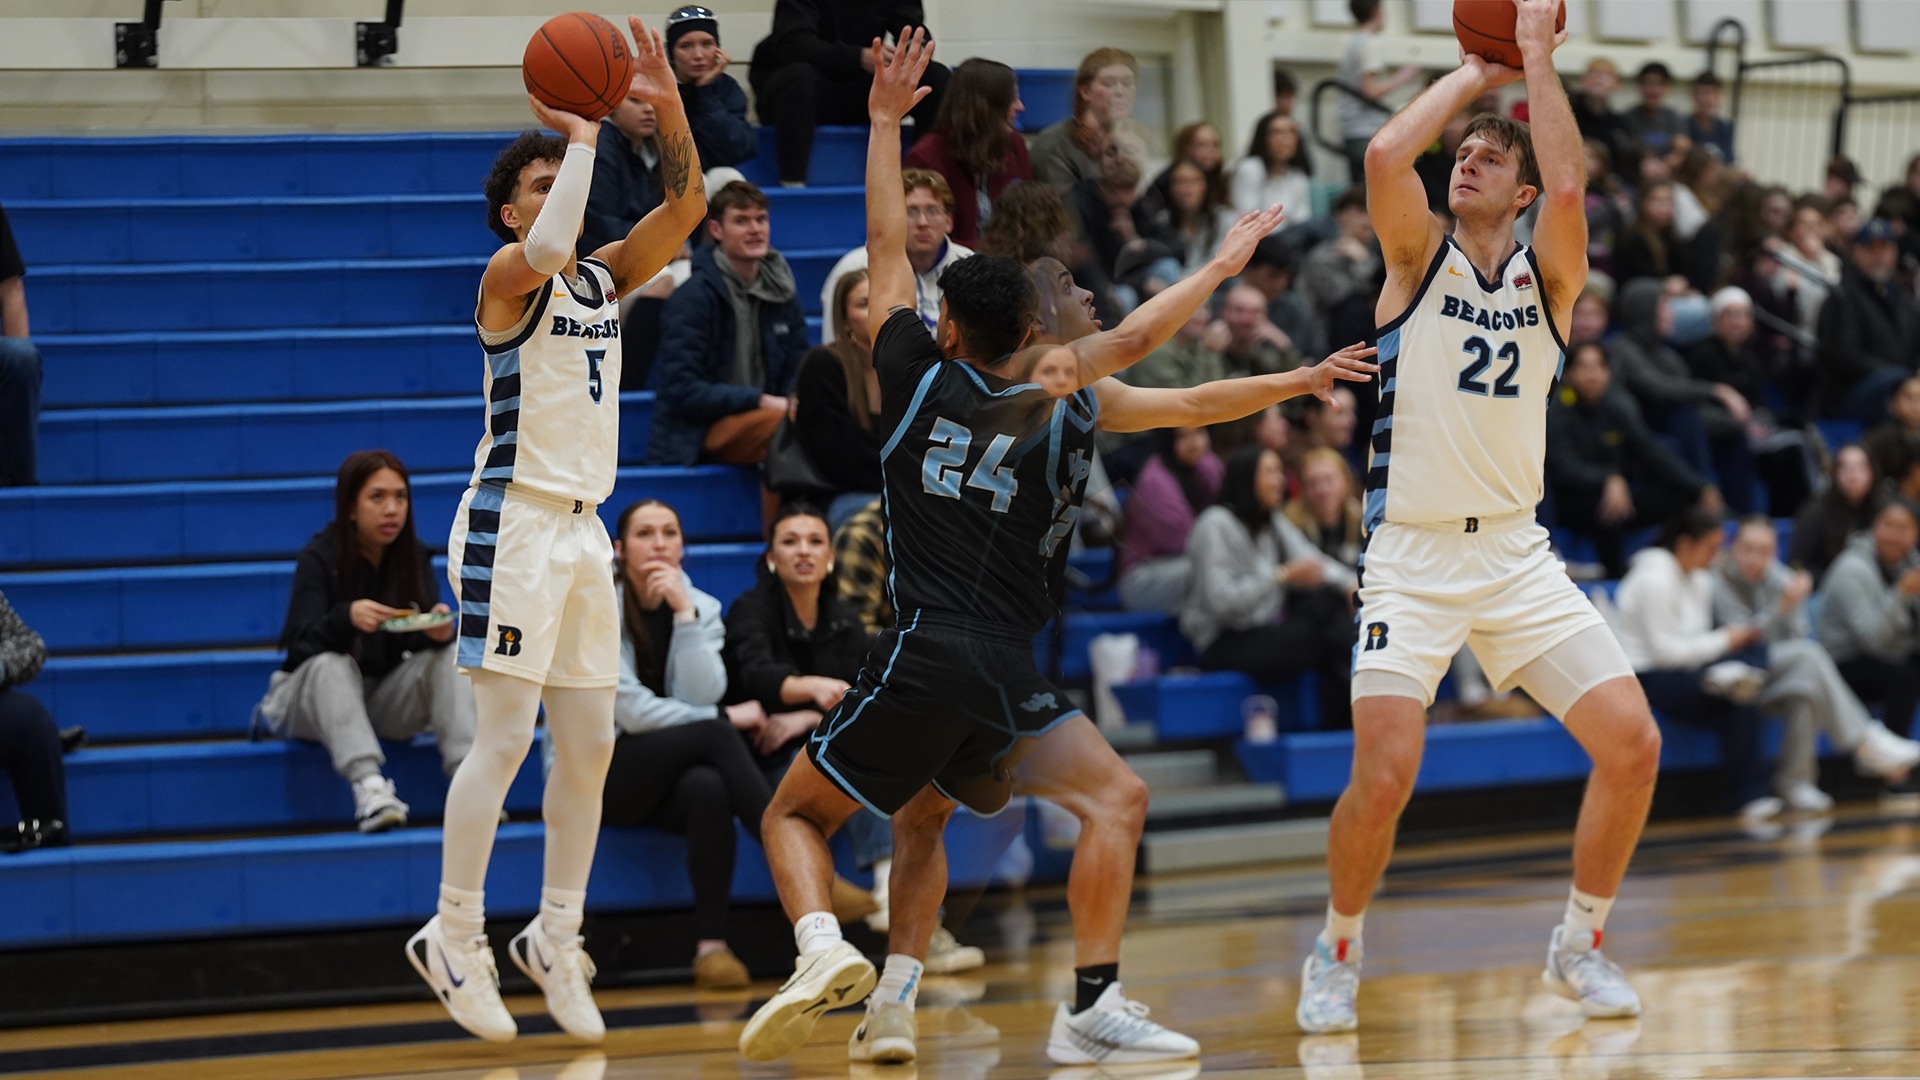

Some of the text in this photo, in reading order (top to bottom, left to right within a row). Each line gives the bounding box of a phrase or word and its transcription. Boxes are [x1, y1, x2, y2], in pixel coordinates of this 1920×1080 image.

[1440, 294, 1539, 331] BEACONS
[584, 348, 607, 405] 5
[1457, 335, 1520, 398] 22
[922, 416, 1018, 513] 24
[494, 624, 523, 657] B
[1364, 621, 1389, 652] B
